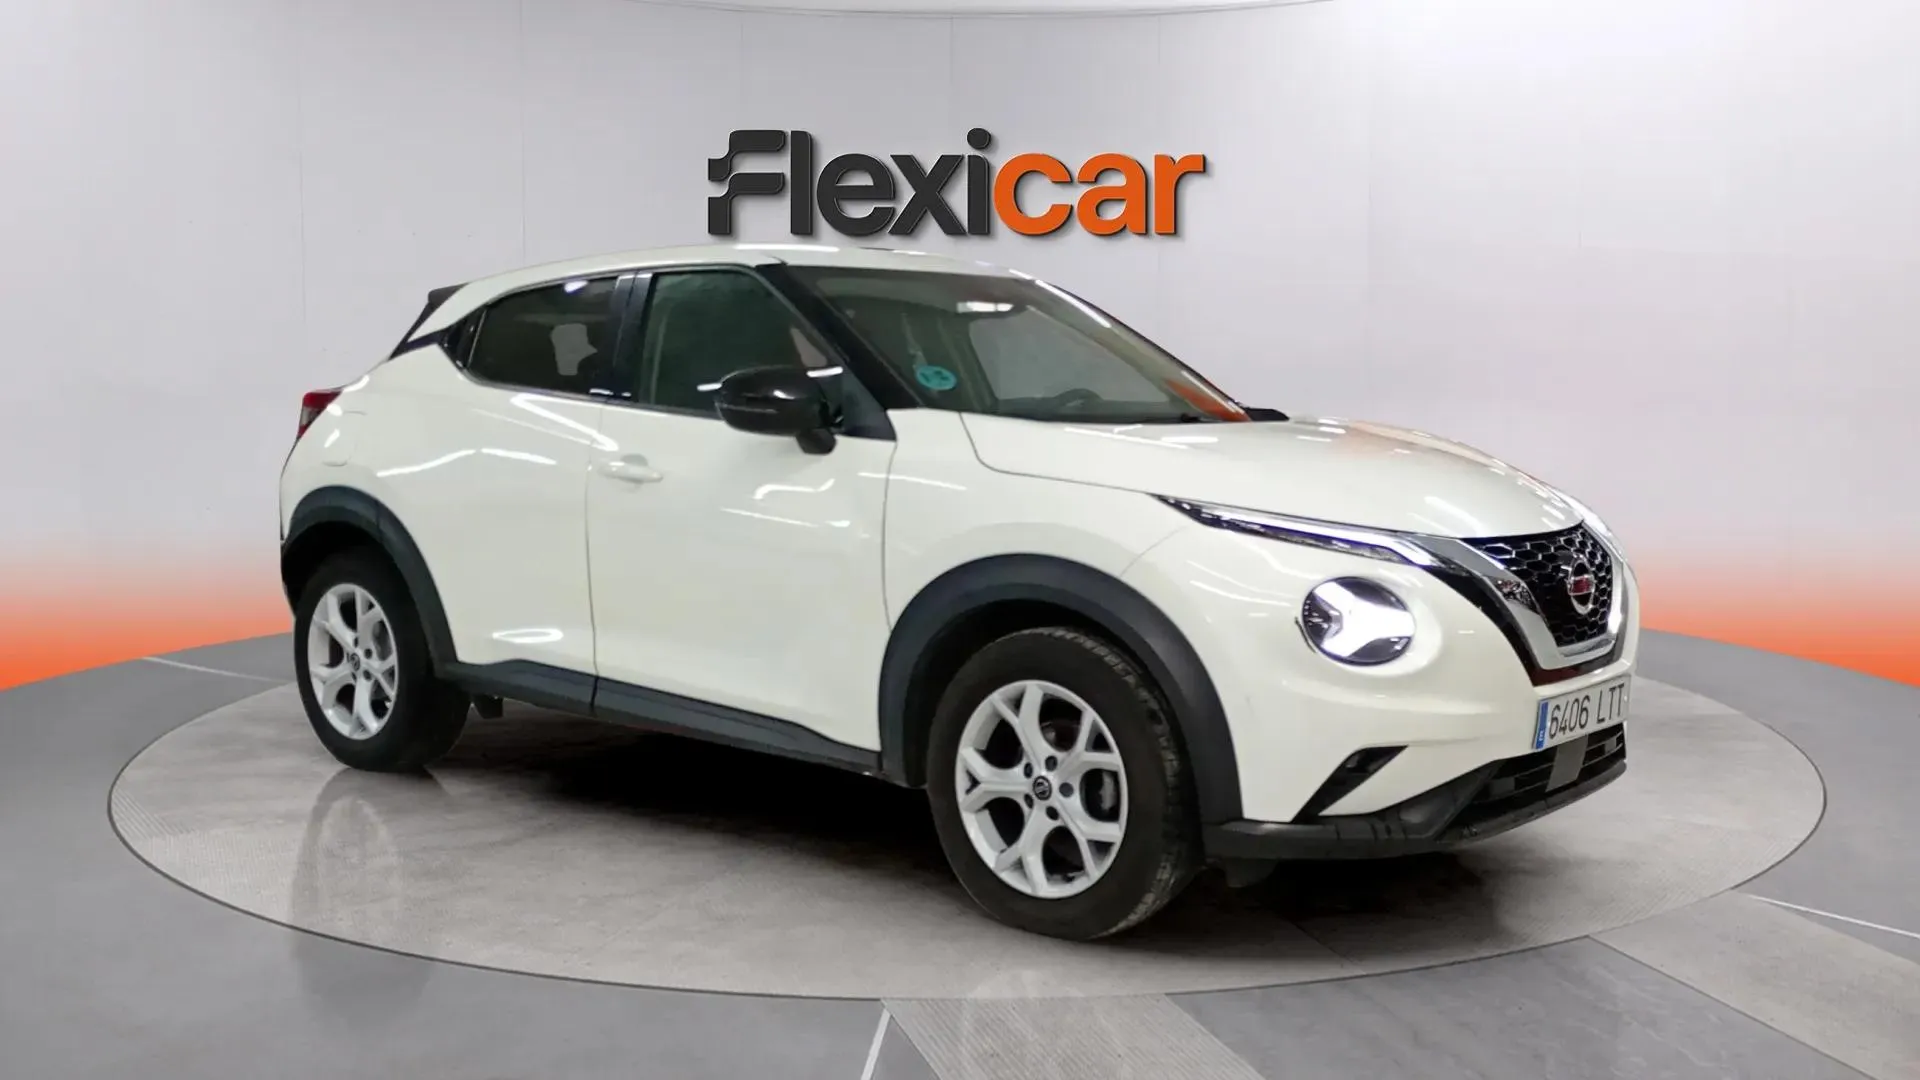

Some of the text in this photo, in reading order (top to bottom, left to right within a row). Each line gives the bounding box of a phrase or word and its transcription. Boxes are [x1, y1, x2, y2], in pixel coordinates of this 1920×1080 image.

[708, 128, 1205, 235] Flexicar
[1549, 683, 1625, 739] 6406 LTT
